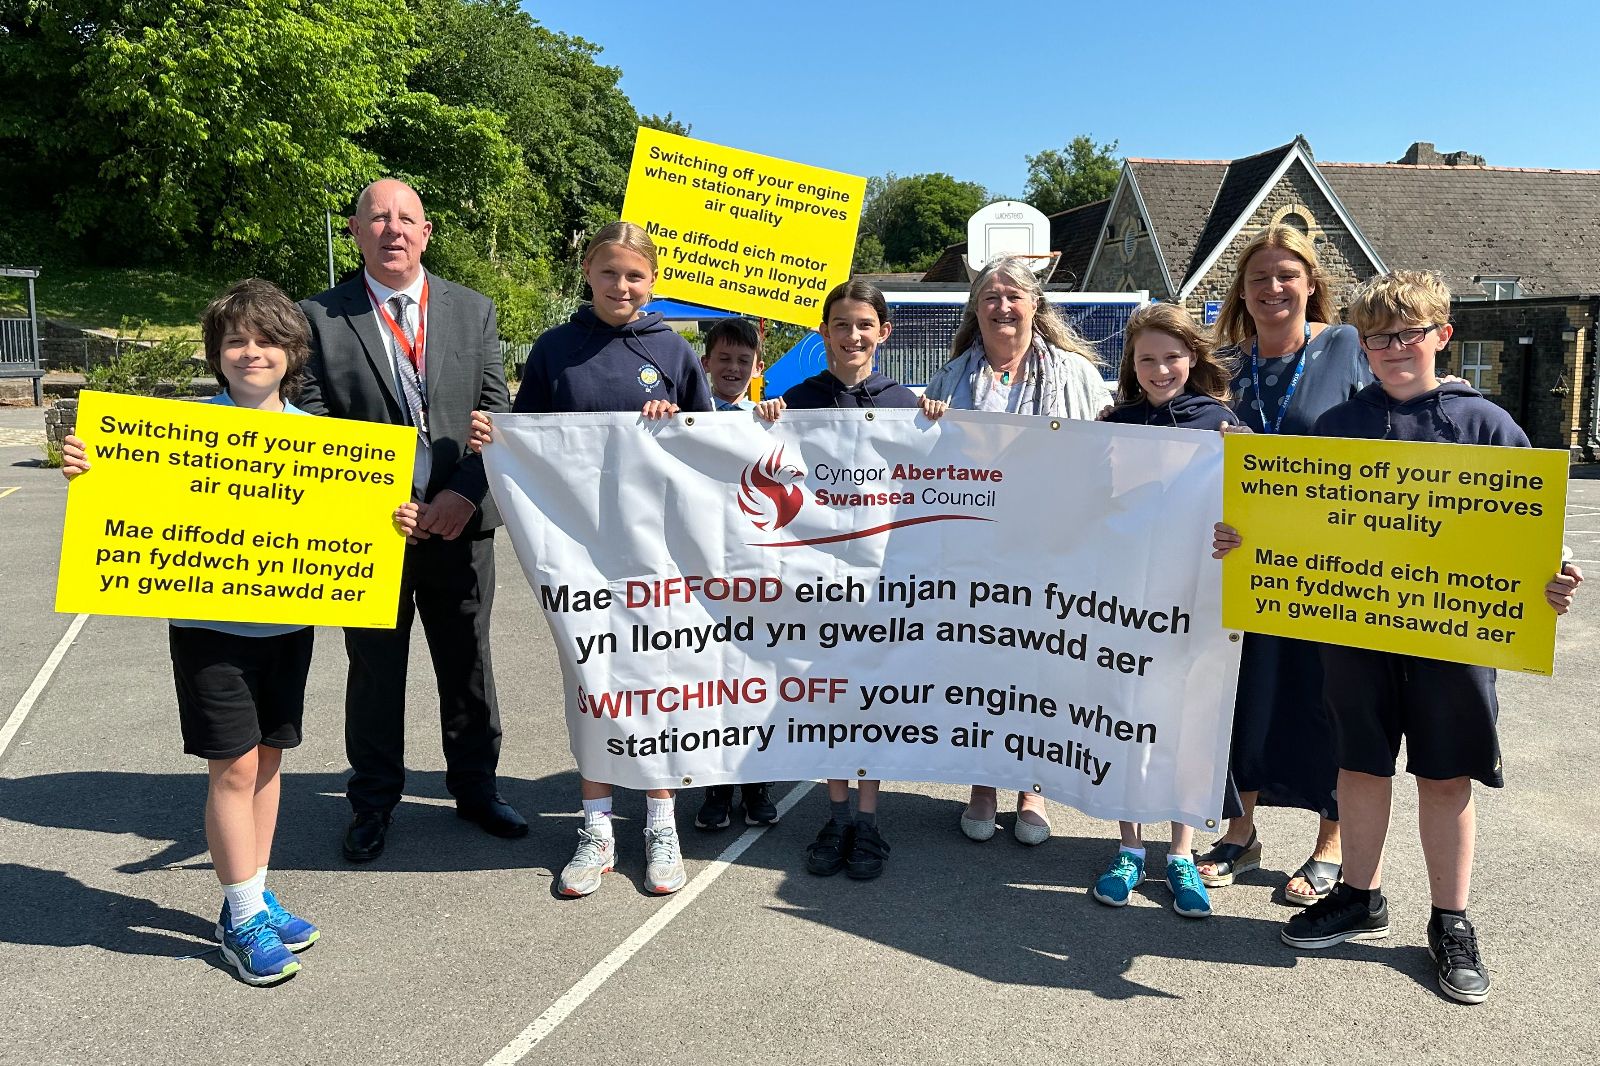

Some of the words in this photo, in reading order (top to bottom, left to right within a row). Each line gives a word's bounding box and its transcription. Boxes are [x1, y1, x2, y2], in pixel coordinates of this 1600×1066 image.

[646, 167, 686, 184] when
[692, 177, 770, 207] stationary
[776, 196, 847, 220] improves
[649, 147, 727, 178] Switching
[733, 168, 754, 180] off
[757, 177, 793, 189] your
[798, 184, 849, 202] engine
[705, 200, 723, 211] air
[730, 206, 782, 227] quality
[646, 221, 677, 239] Mae
[683, 231, 738, 253] diffodd
[743, 247, 775, 261] eich
[781, 255, 827, 271] motor
[664, 267, 714, 286] gwella
[719, 280, 789, 302] ansawdd
[794, 296, 819, 307] aer
[674, 246, 739, 272] fyddwch
[744, 266, 763, 277] yn
[769, 268, 826, 291] llonydd
[100, 416, 218, 447] Switching
[228, 431, 258, 447] off
[264, 438, 315, 453] your
[323, 444, 395, 462] engine
[96, 443, 159, 463] when
[169, 451, 285, 479] stationary
[294, 461, 394, 485] improves
[815, 464, 885, 485] Cyngor
[891, 464, 1002, 482] Abertawe
[1244, 455, 1351, 480] Switching
[1360, 462, 1390, 478] off
[1397, 468, 1451, 484] your
[1459, 470, 1543, 491] engine
[191, 477, 220, 493] air
[228, 483, 304, 505] quality
[816, 489, 914, 506] Swansea
[922, 488, 995, 506] Council
[1241, 479, 1297, 496] when
[1306, 484, 1419, 510] stationary
[1429, 491, 1542, 516] improves
[105, 520, 153, 539] Mae
[163, 525, 244, 545] diffodd
[253, 532, 298, 549] eich
[308, 539, 372, 554] motor
[1328, 509, 1356, 525] air
[1364, 514, 1441, 537] quality
[96, 549, 140, 565] pan
[150, 549, 248, 570] fyddwch
[257, 560, 283, 576] yn
[293, 558, 373, 580] llonydd
[1256, 549, 1298, 567] Mae
[1306, 554, 1383, 577] diffodd
[1391, 564, 1438, 583] eich
[1448, 573, 1520, 592] motor
[100, 575, 128, 591] yn
[138, 576, 213, 594] gwella
[222, 583, 323, 599] ansawdd
[331, 589, 365, 601] aer
[541, 585, 612, 612] Mae
[627, 576, 782, 608] DIFFODD
[796, 576, 864, 602] eich
[879, 575, 955, 608] injan
[970, 582, 1031, 608] pan
[1045, 583, 1189, 634] fyddwch
[1251, 575, 1288, 590] pan
[1296, 576, 1389, 602] fyddwch
[1398, 592, 1424, 608] yn
[1434, 592, 1523, 619] llonydd
[1256, 598, 1280, 613] yn
[1289, 603, 1356, 622] gwella
[1365, 612, 1468, 637] ansawdd
[1477, 628, 1515, 643] aer
[576, 633, 616, 664] yn
[633, 616, 753, 653] llonydd
[766, 623, 805, 647] yn
[819, 617, 923, 647] gwella
[937, 622, 1087, 661] ansawdd
[1097, 647, 1153, 676] aer
[578, 678, 766, 719] SWITCHING
[780, 677, 848, 703] OFF
[860, 684, 935, 710] your
[945, 685, 1057, 716] engine
[1069, 705, 1156, 744] when
[607, 725, 775, 757] stationary
[788, 718, 938, 748] improves
[951, 722, 994, 748] air
[1005, 734, 1111, 785] quality
